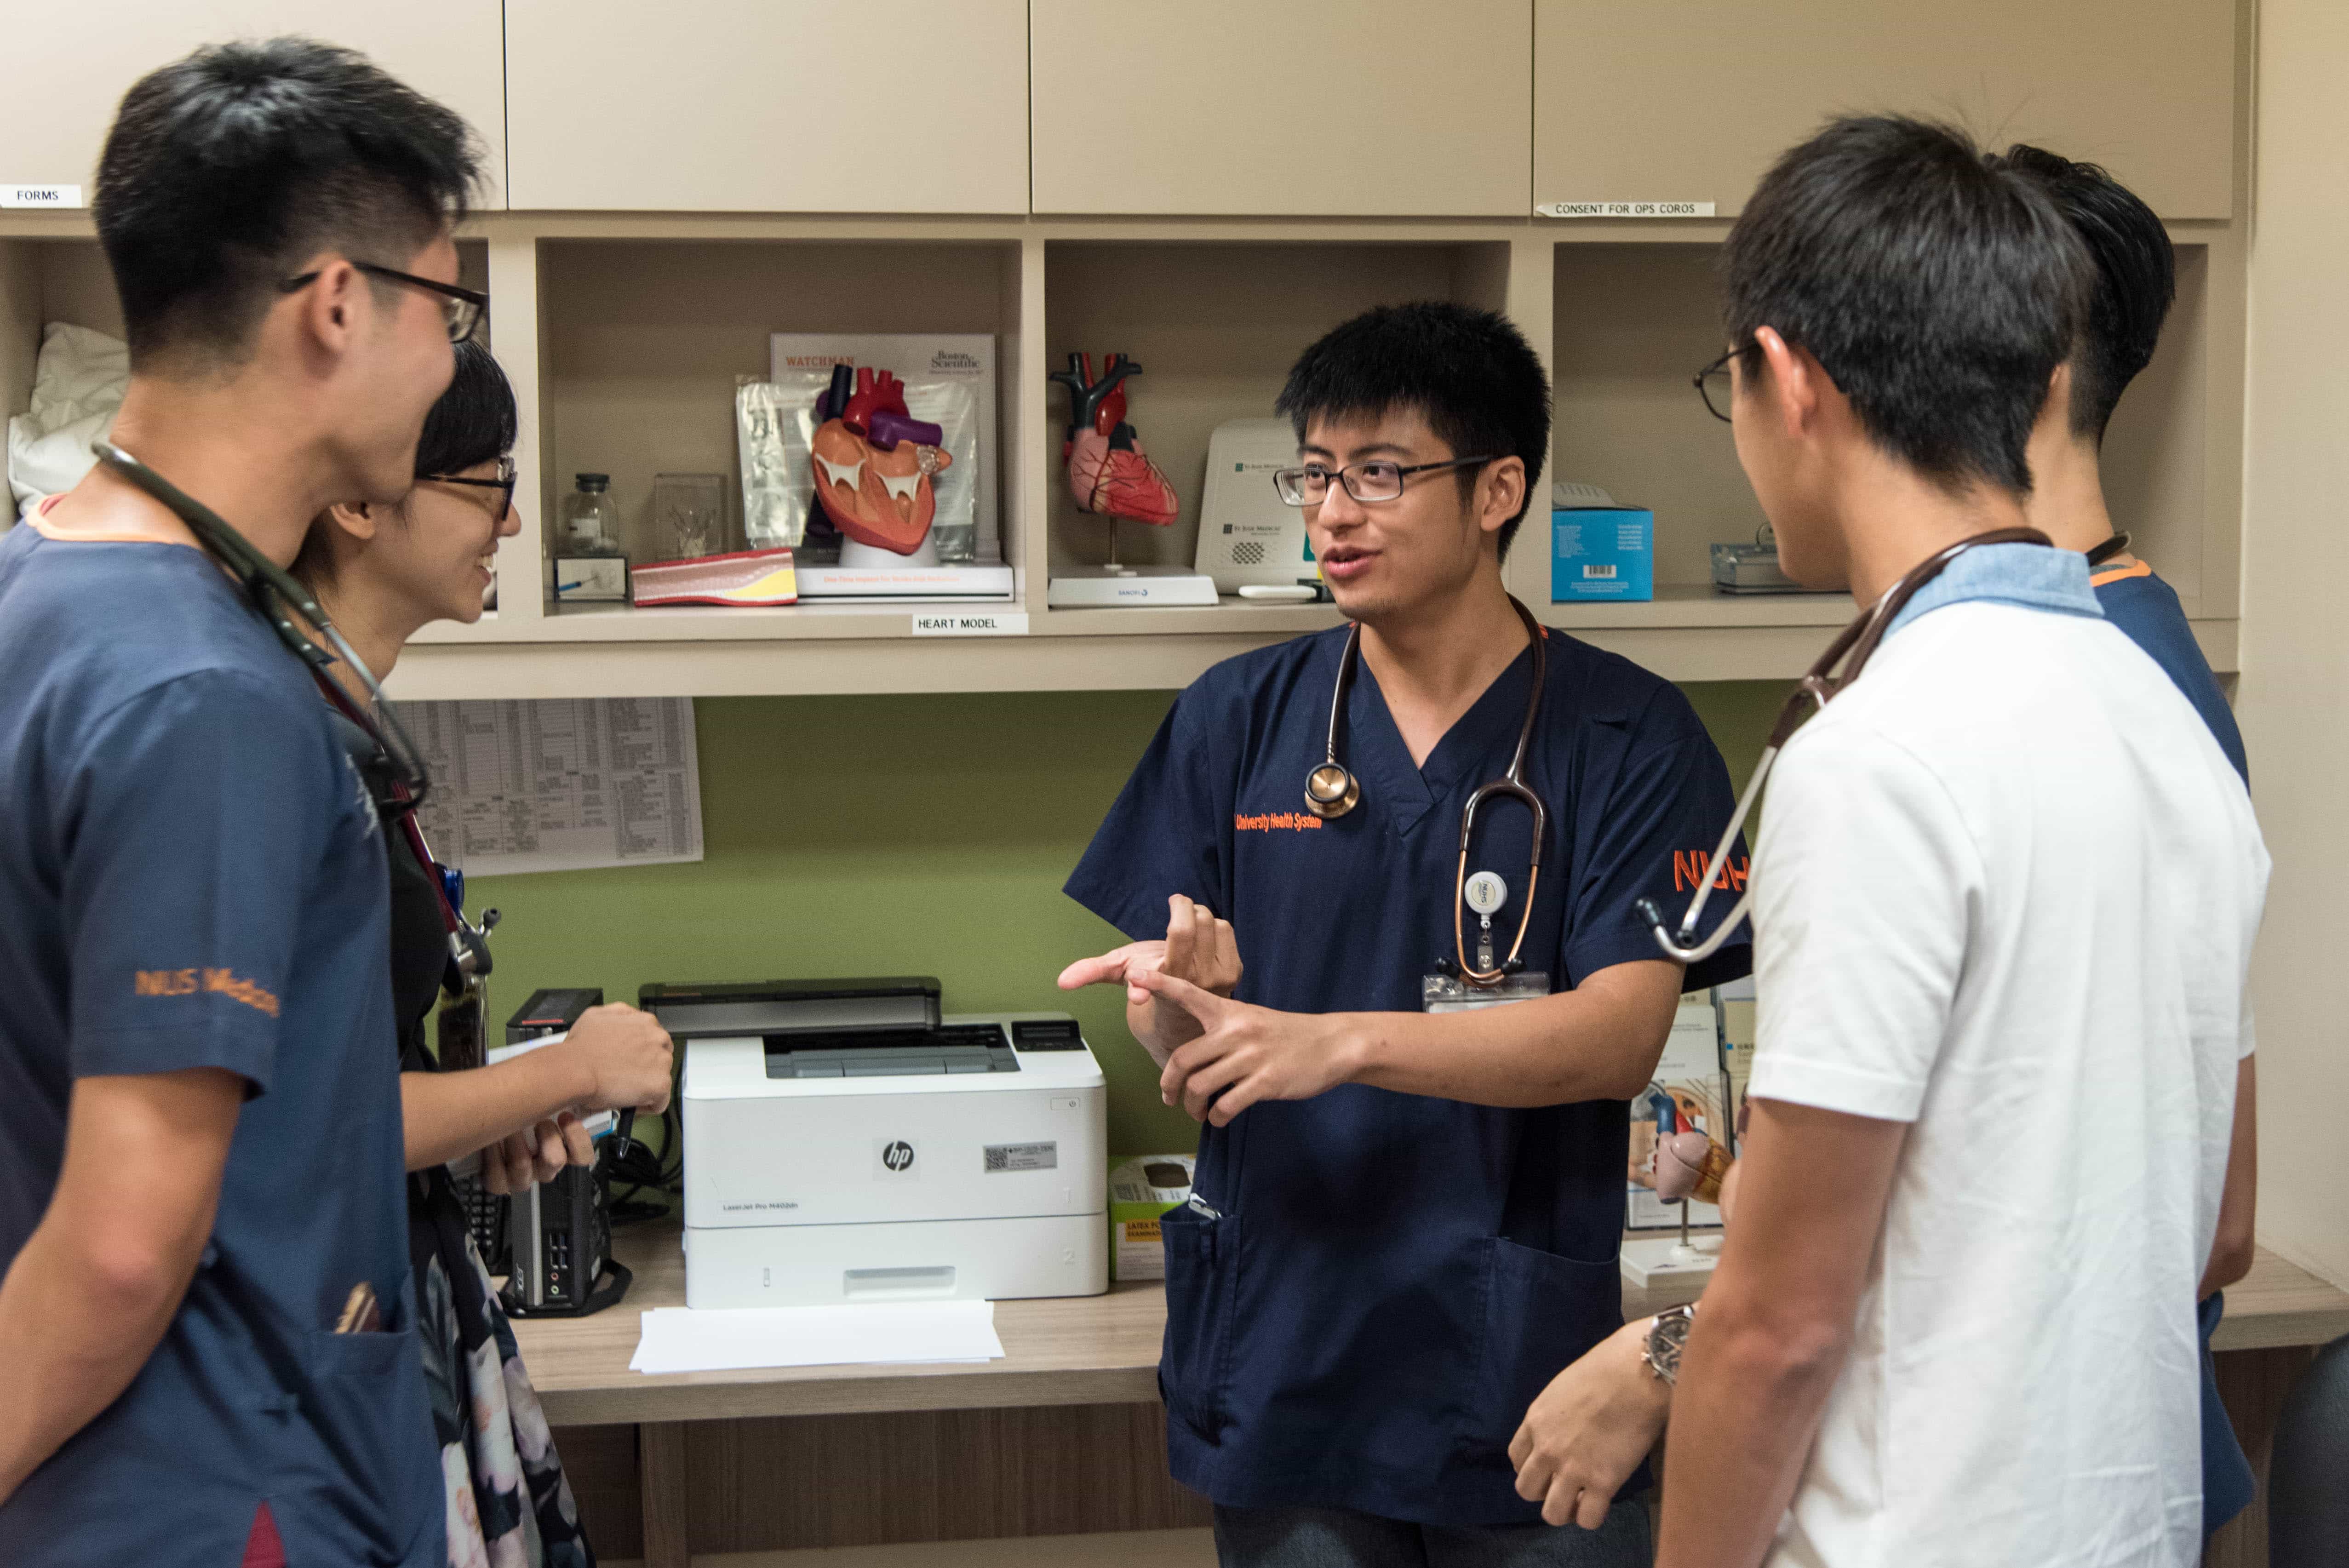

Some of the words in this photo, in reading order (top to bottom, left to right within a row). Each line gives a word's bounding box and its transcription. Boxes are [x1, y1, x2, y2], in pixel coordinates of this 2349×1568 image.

[17, 190, 58, 200] FORMS
[1556, 205, 1604, 214] CONSENT
[1609, 205, 1629, 213] FOR
[1635, 204, 1655, 213] OPS
[1660, 204, 1695, 213] COROS
[786, 355, 854, 367] WATCHMAN
[918, 618, 955, 628] HEART
[960, 618, 997, 628] MODEL
[1236, 813, 1270, 833] University
[1270, 811, 1294, 829] Health
[1294, 812, 1322, 832] System
[135, 968, 198, 997] NUS
[886, 1140, 911, 1171] hp
[723, 1202, 753, 1211] LaserJet
